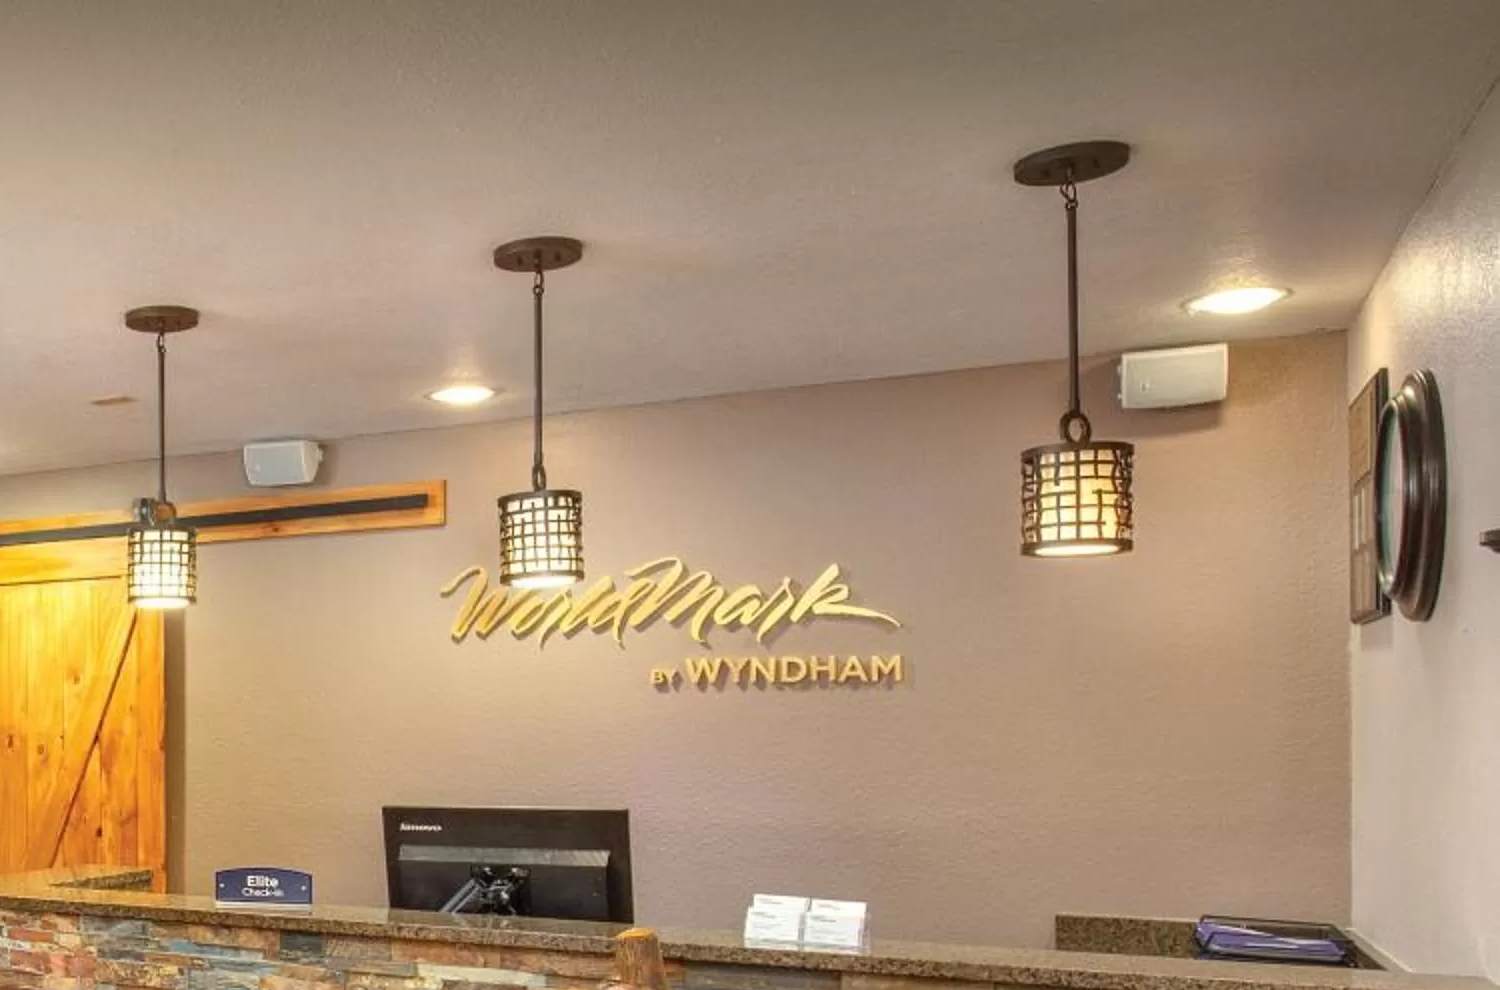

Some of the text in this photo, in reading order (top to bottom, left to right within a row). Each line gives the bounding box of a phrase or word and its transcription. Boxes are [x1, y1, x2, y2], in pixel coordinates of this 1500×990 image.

[440, 556, 902, 648] WorldMark
[651, 654, 902, 684] BY WYNDHAM
[246, 875, 279, 888] Elite
